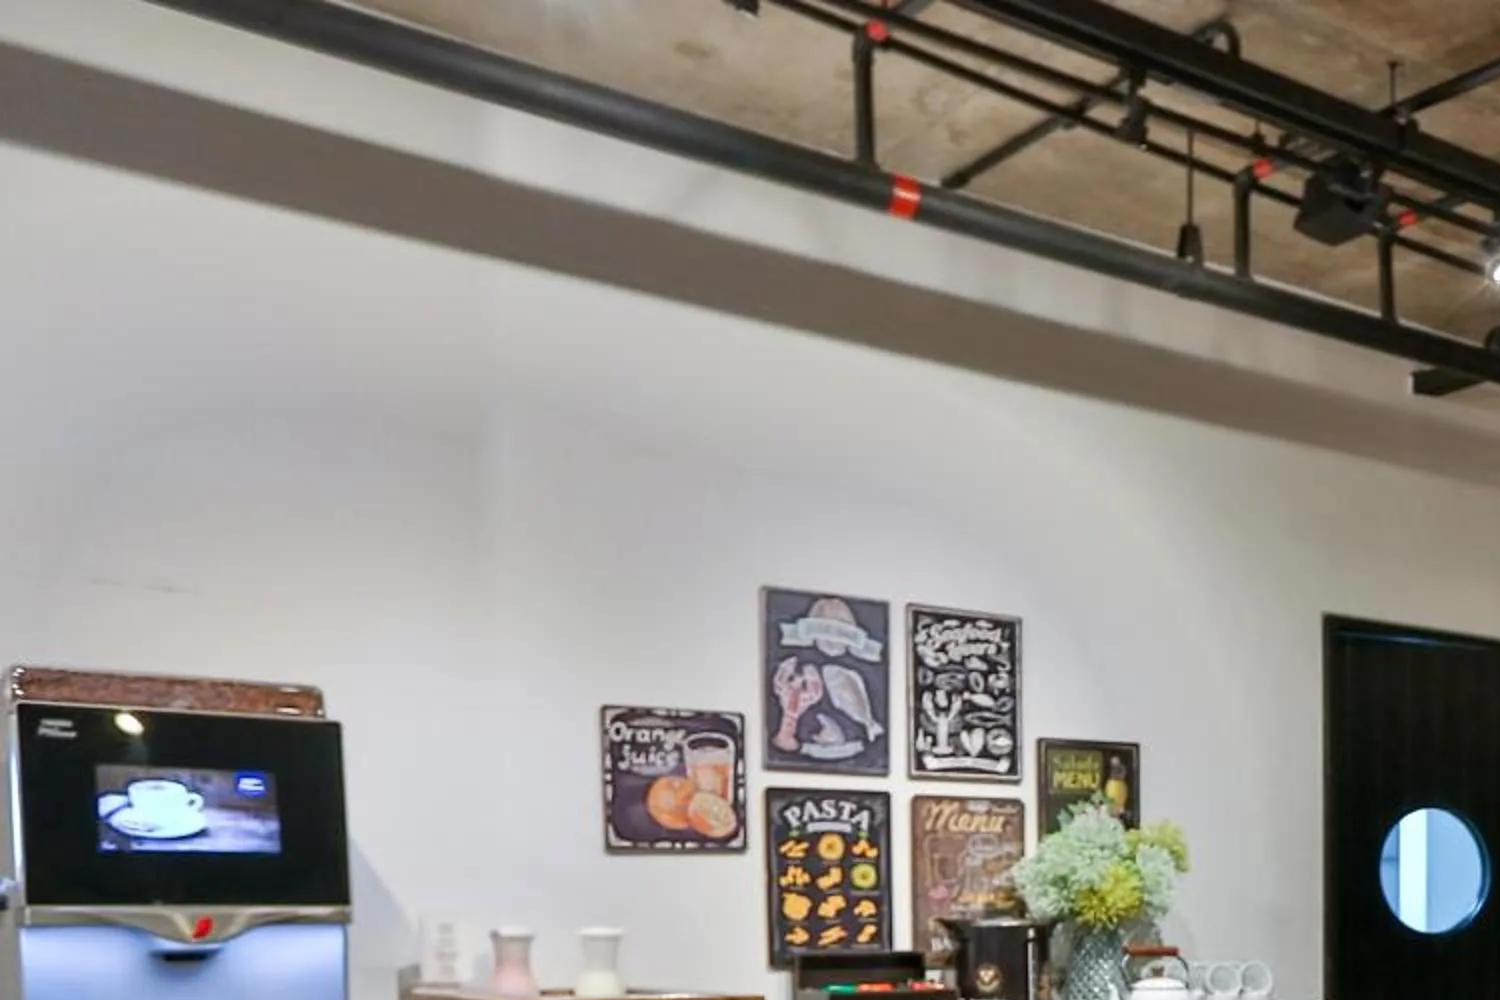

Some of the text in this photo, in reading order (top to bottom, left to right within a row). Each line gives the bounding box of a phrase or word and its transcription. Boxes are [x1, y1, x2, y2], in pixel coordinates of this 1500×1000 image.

[609, 721, 687, 749] Orange
[1052, 770, 1101, 790] MENU
[783, 799, 870, 833] PASTA
[923, 801, 1006, 834] Menu
